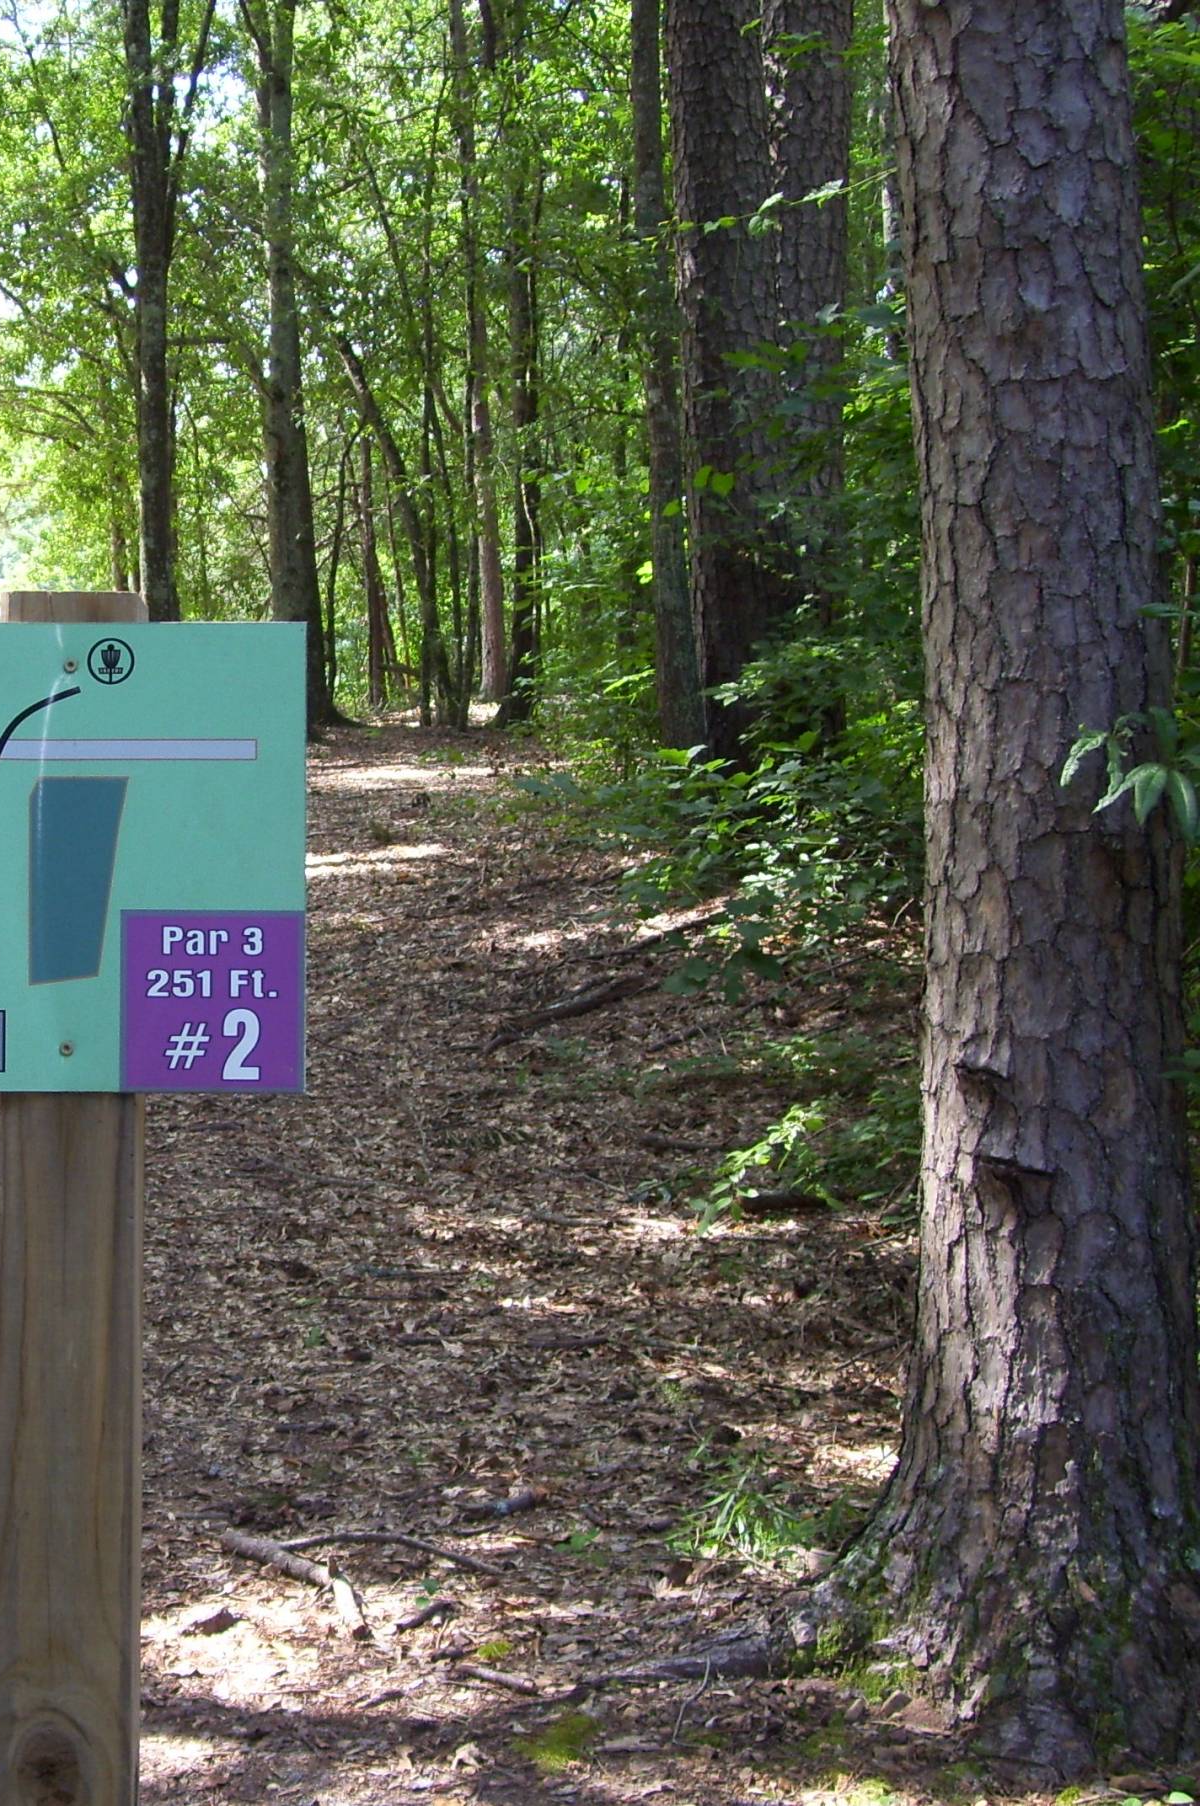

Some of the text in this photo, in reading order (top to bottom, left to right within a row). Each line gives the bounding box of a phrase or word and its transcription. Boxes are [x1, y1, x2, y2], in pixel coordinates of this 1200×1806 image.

[162, 926, 264, 957] Par 3
[146, 968, 279, 999] 251 Ft.
